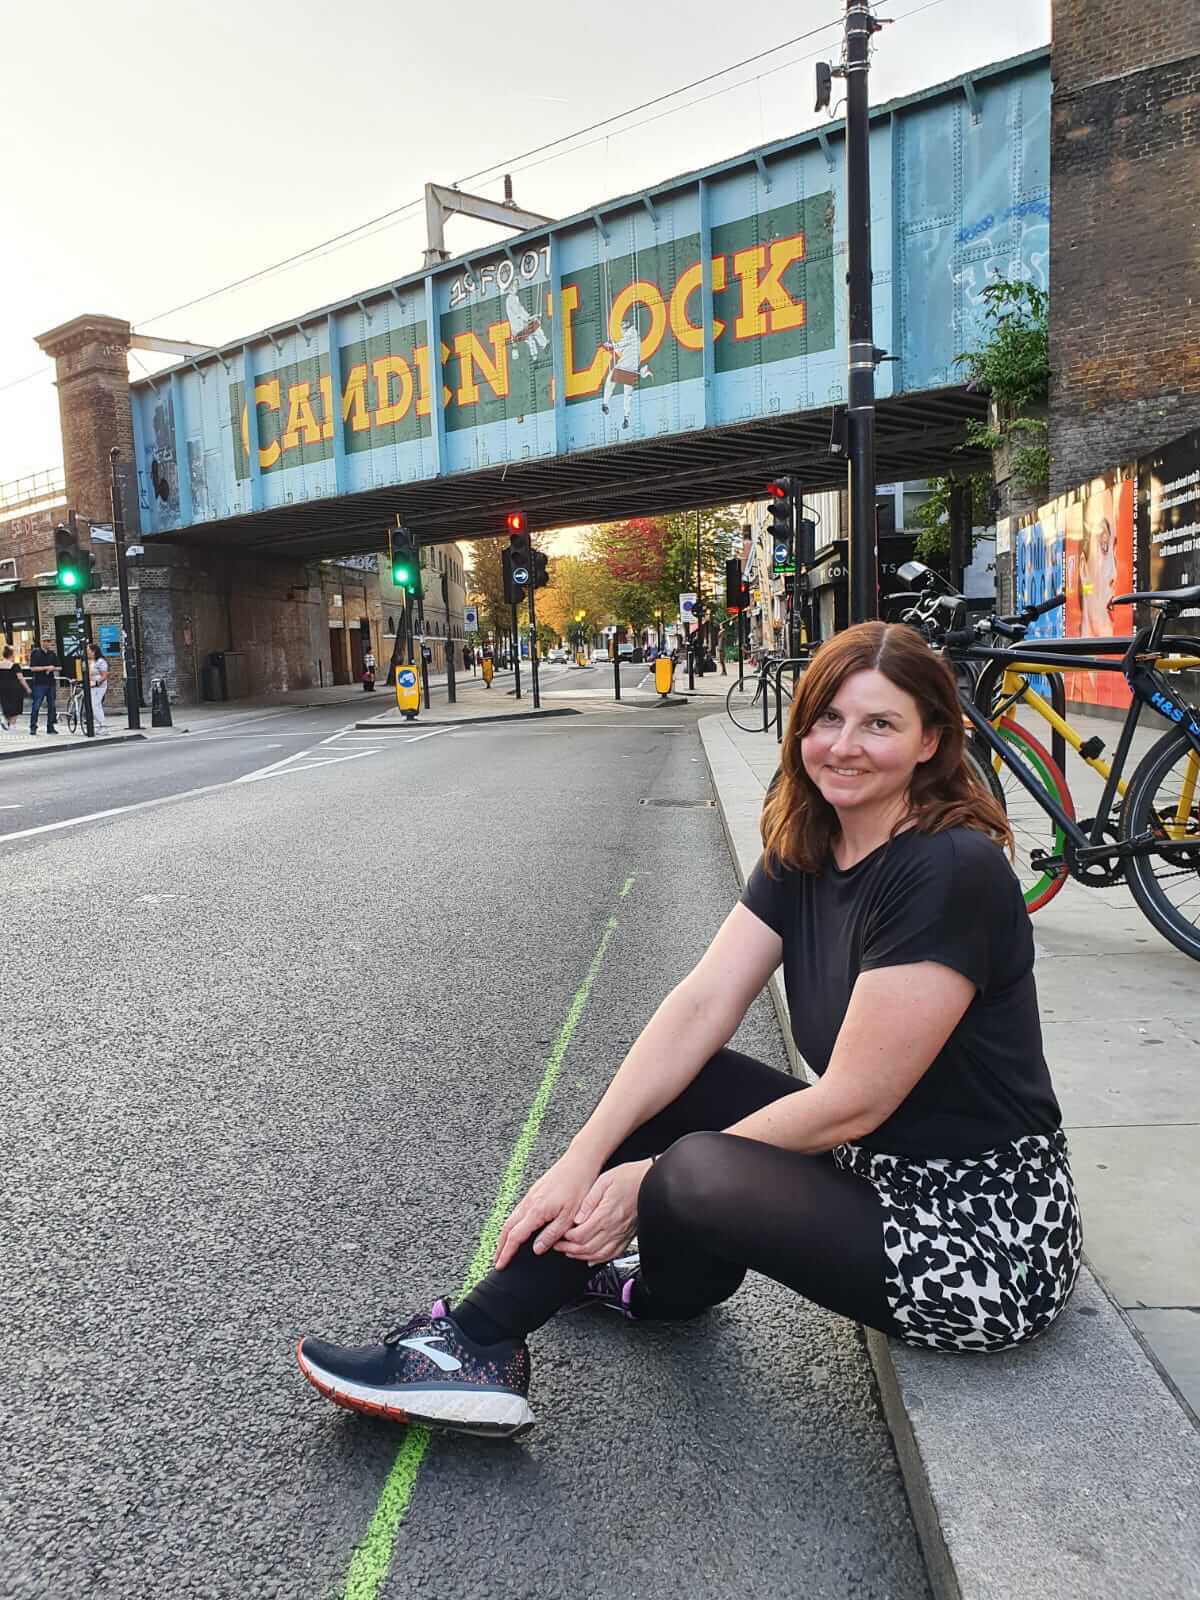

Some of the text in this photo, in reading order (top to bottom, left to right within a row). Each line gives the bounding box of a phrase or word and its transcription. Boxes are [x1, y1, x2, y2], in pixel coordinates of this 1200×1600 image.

[239, 233, 805, 468] CAMDEN LOCK
[1151, 692, 1184, 721] H&S
